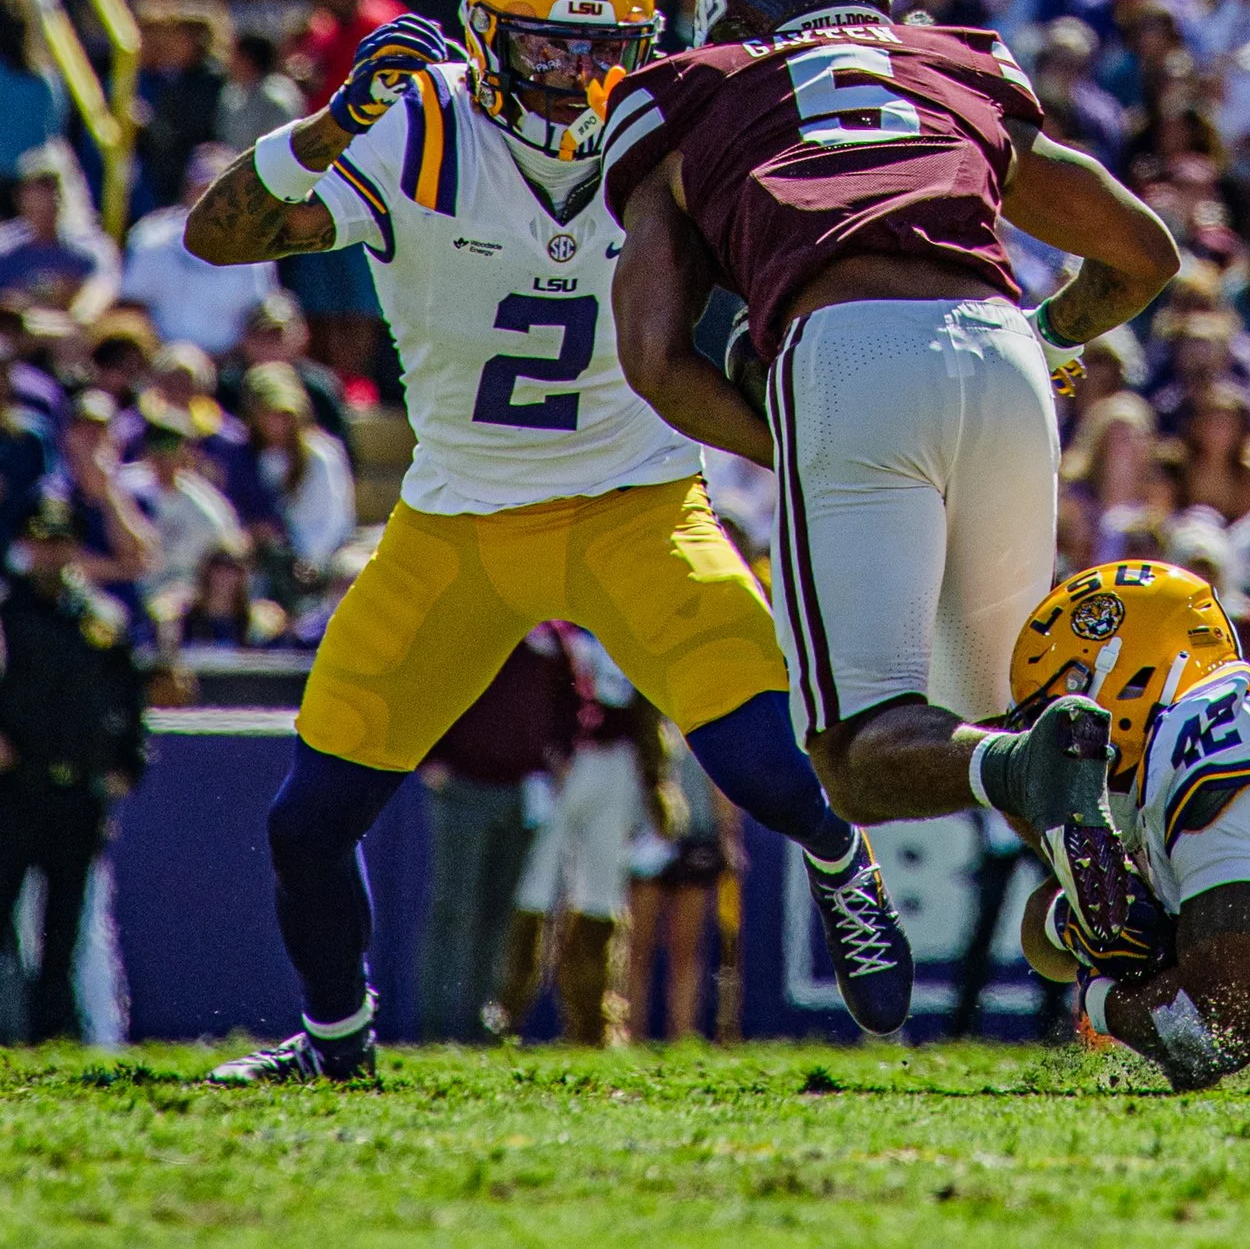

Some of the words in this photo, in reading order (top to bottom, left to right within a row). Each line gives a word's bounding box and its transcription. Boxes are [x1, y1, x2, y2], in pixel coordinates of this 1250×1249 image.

[568, 1, 603, 16] LSU
[786, 43, 921, 148] 5
[469, 246, 494, 257] Energy
[549, 235, 577, 263] SEC
[532, 277, 578, 292] LSU
[472, 293, 599, 431] 2
[1030, 564, 1153, 636] LSU
[1170, 692, 1244, 770] 42
